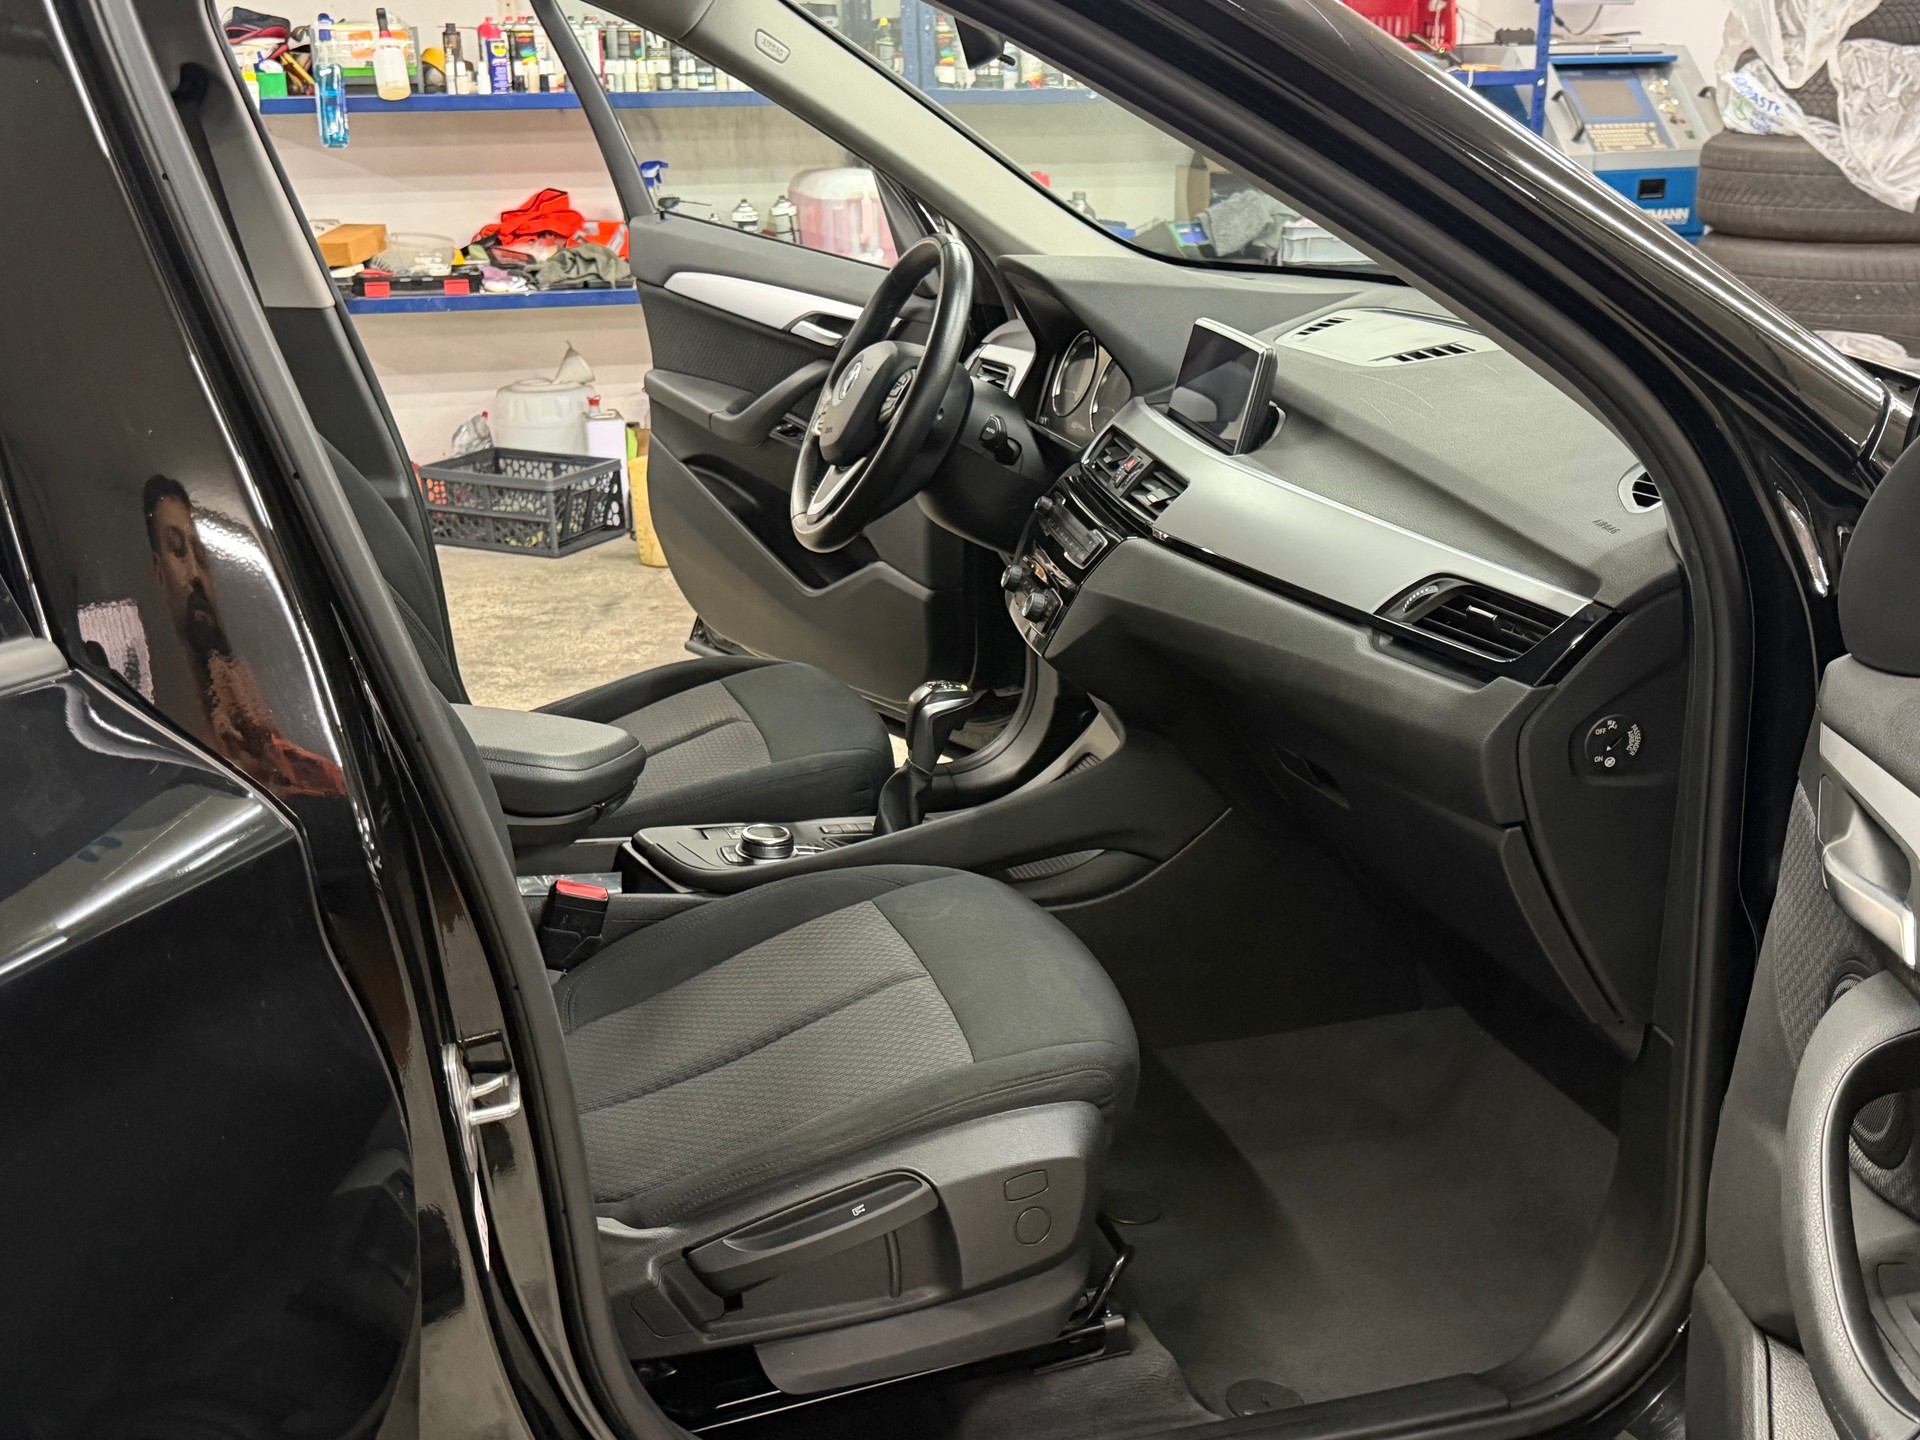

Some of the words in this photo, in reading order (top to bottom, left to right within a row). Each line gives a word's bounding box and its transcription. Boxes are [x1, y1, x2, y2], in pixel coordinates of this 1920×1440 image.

[1592, 519, 1621, 534] AIRBAG
[1595, 727, 1607, 736] OFF
[1629, 723, 1642, 757] PASSENGER
